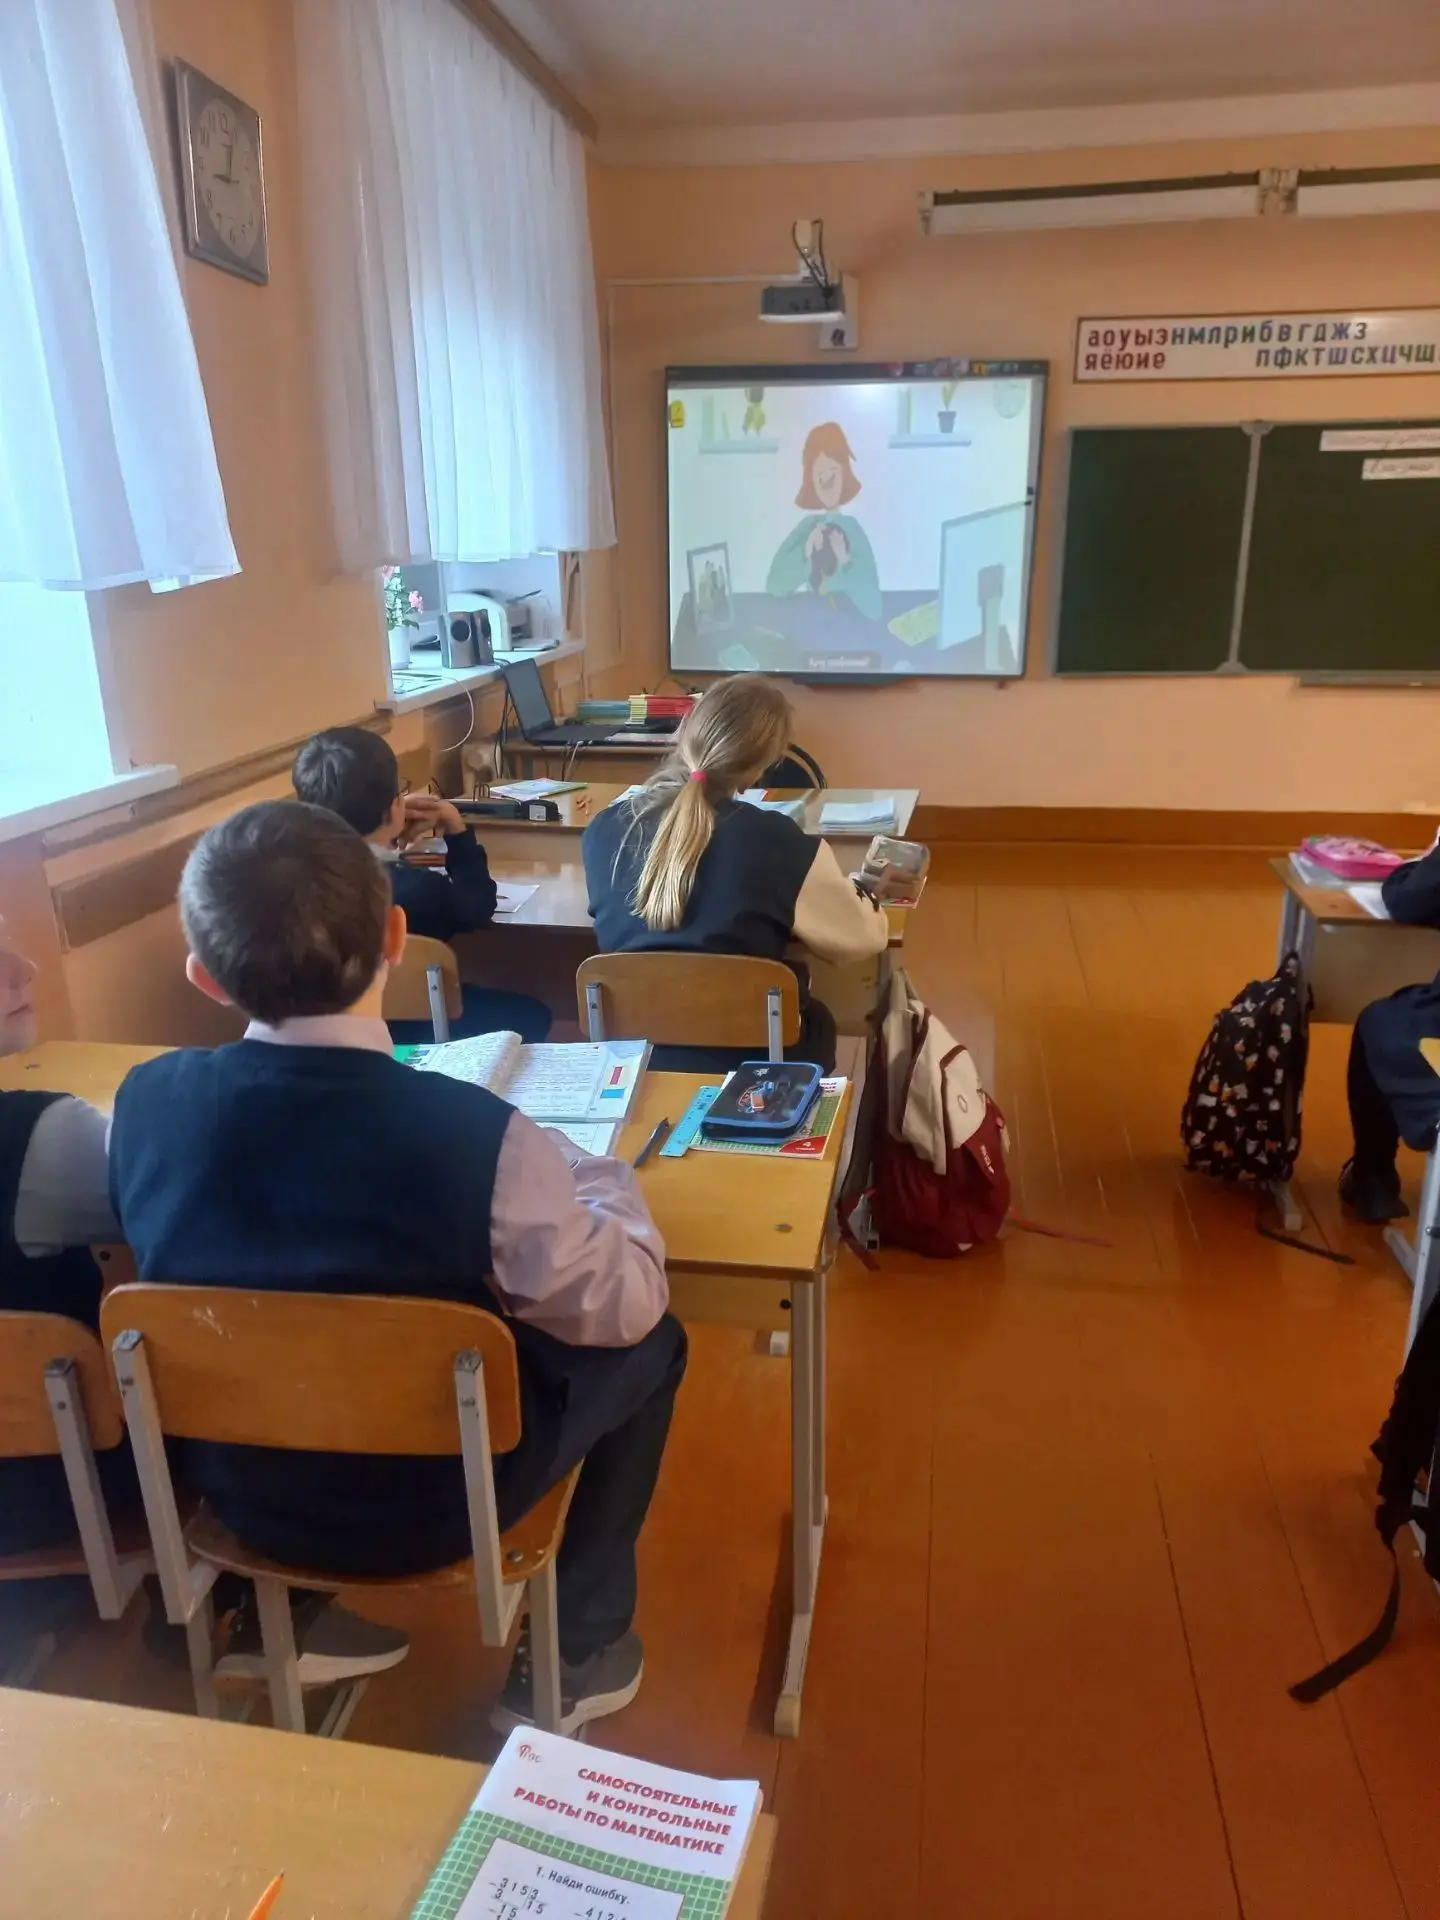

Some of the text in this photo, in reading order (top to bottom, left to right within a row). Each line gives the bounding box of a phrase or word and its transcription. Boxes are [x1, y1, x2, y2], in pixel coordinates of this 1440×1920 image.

[577, 1768, 738, 1817] САМОСТОЯТЕЛЬНЫЕ
[586, 1790, 732, 1837] И КОНТРОЛЬНЫЕ
[513, 1787, 725, 1855] РАБОТЫ ПО МАТЕМАТИКЕ
[548, 1869, 584, 1890] Найди
